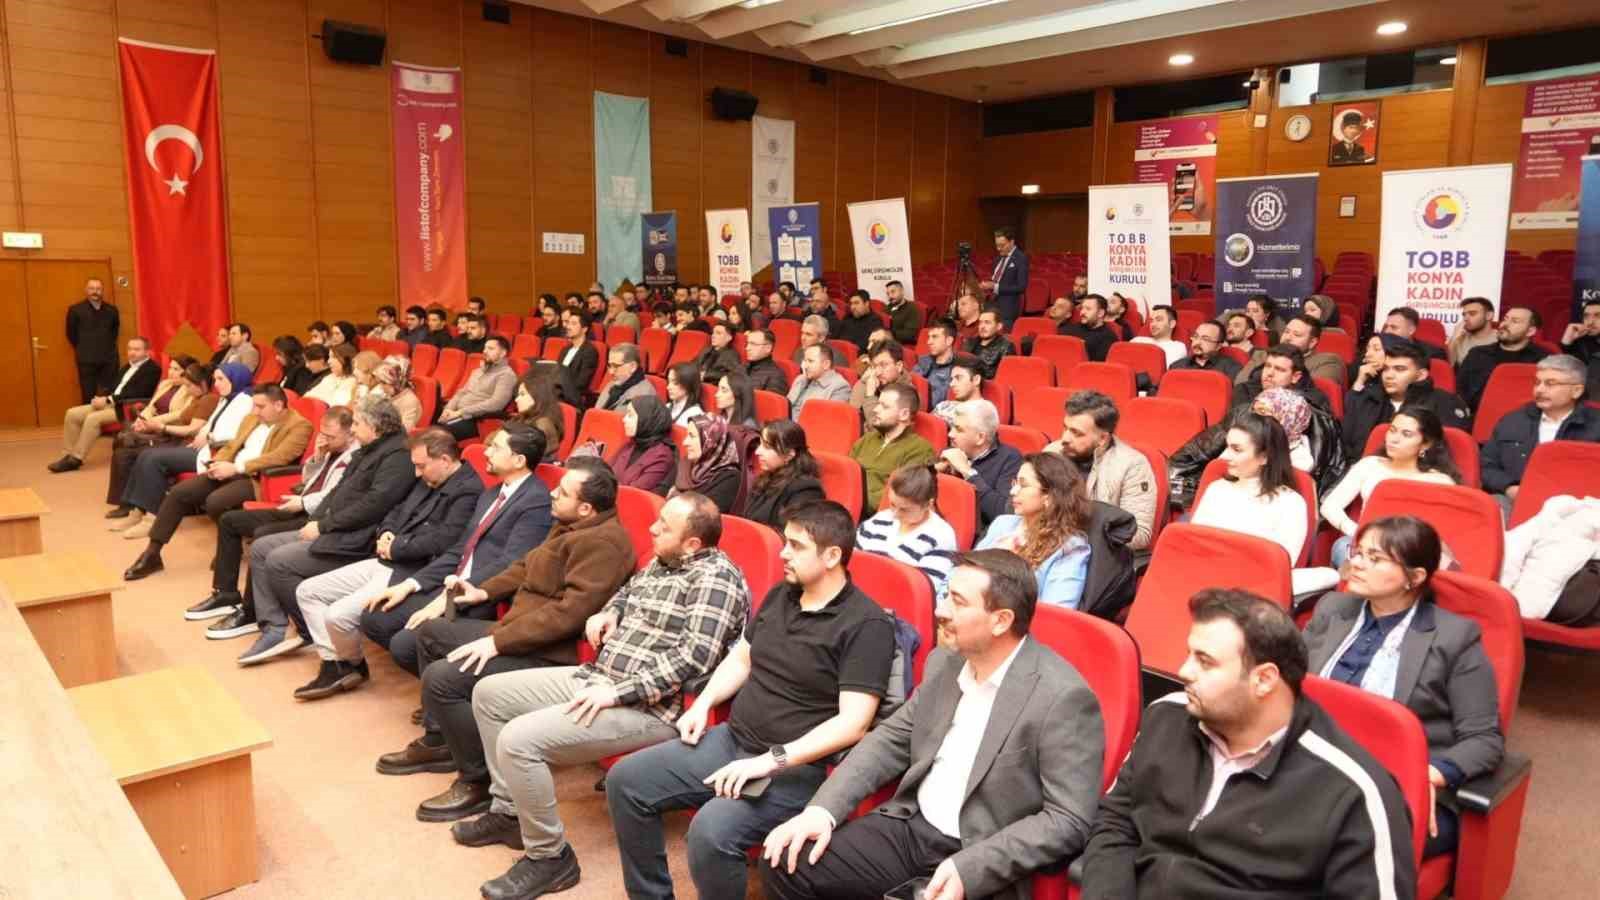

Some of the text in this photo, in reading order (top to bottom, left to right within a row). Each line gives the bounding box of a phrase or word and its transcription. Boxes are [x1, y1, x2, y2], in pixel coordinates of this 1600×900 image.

[416, 122, 432, 272] www.listofcompany.com
[1109, 233, 1146, 244] TOBB
[1109, 245, 1146, 255] KONYA
[718, 255, 739, 265] TOBB
[1109, 256, 1146, 266] KADIN
[1405, 250, 1470, 269] TOBB
[1109, 274, 1146, 284] KURULU
[1407, 271, 1464, 284] KONYA
[1407, 287, 1464, 300] KADIN
